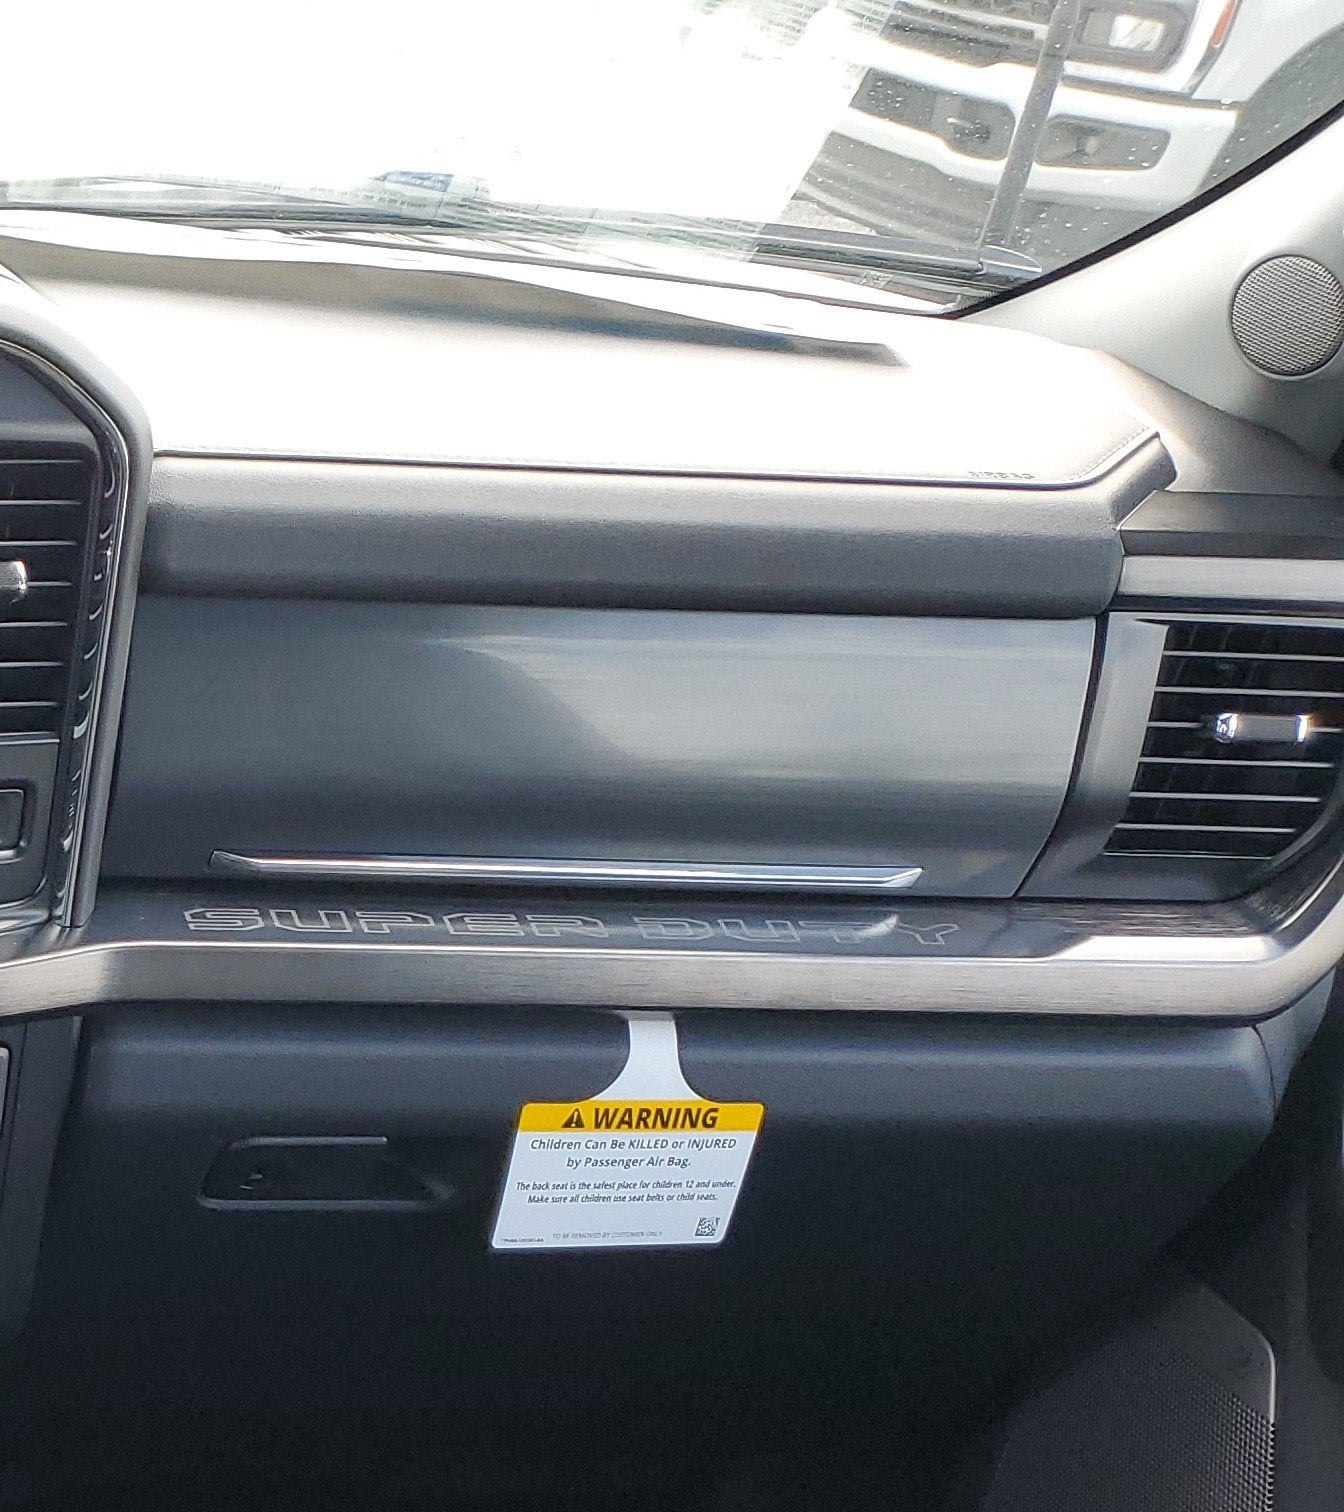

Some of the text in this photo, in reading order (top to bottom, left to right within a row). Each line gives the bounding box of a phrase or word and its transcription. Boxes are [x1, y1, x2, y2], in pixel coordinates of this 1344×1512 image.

[183, 907, 960, 946] SUPER DUTY
[593, 1107, 720, 1130] WARNING
[530, 1138, 737, 1151] Children Can Be KILLED or INJURED
[566, 1155, 692, 1170] by Passenger Air Bag.
[516, 1179, 737, 1191] The back seat is the safest place for children 12 and under.
[527, 1192, 719, 1204] Make sure all children use seat belts or child seats.
